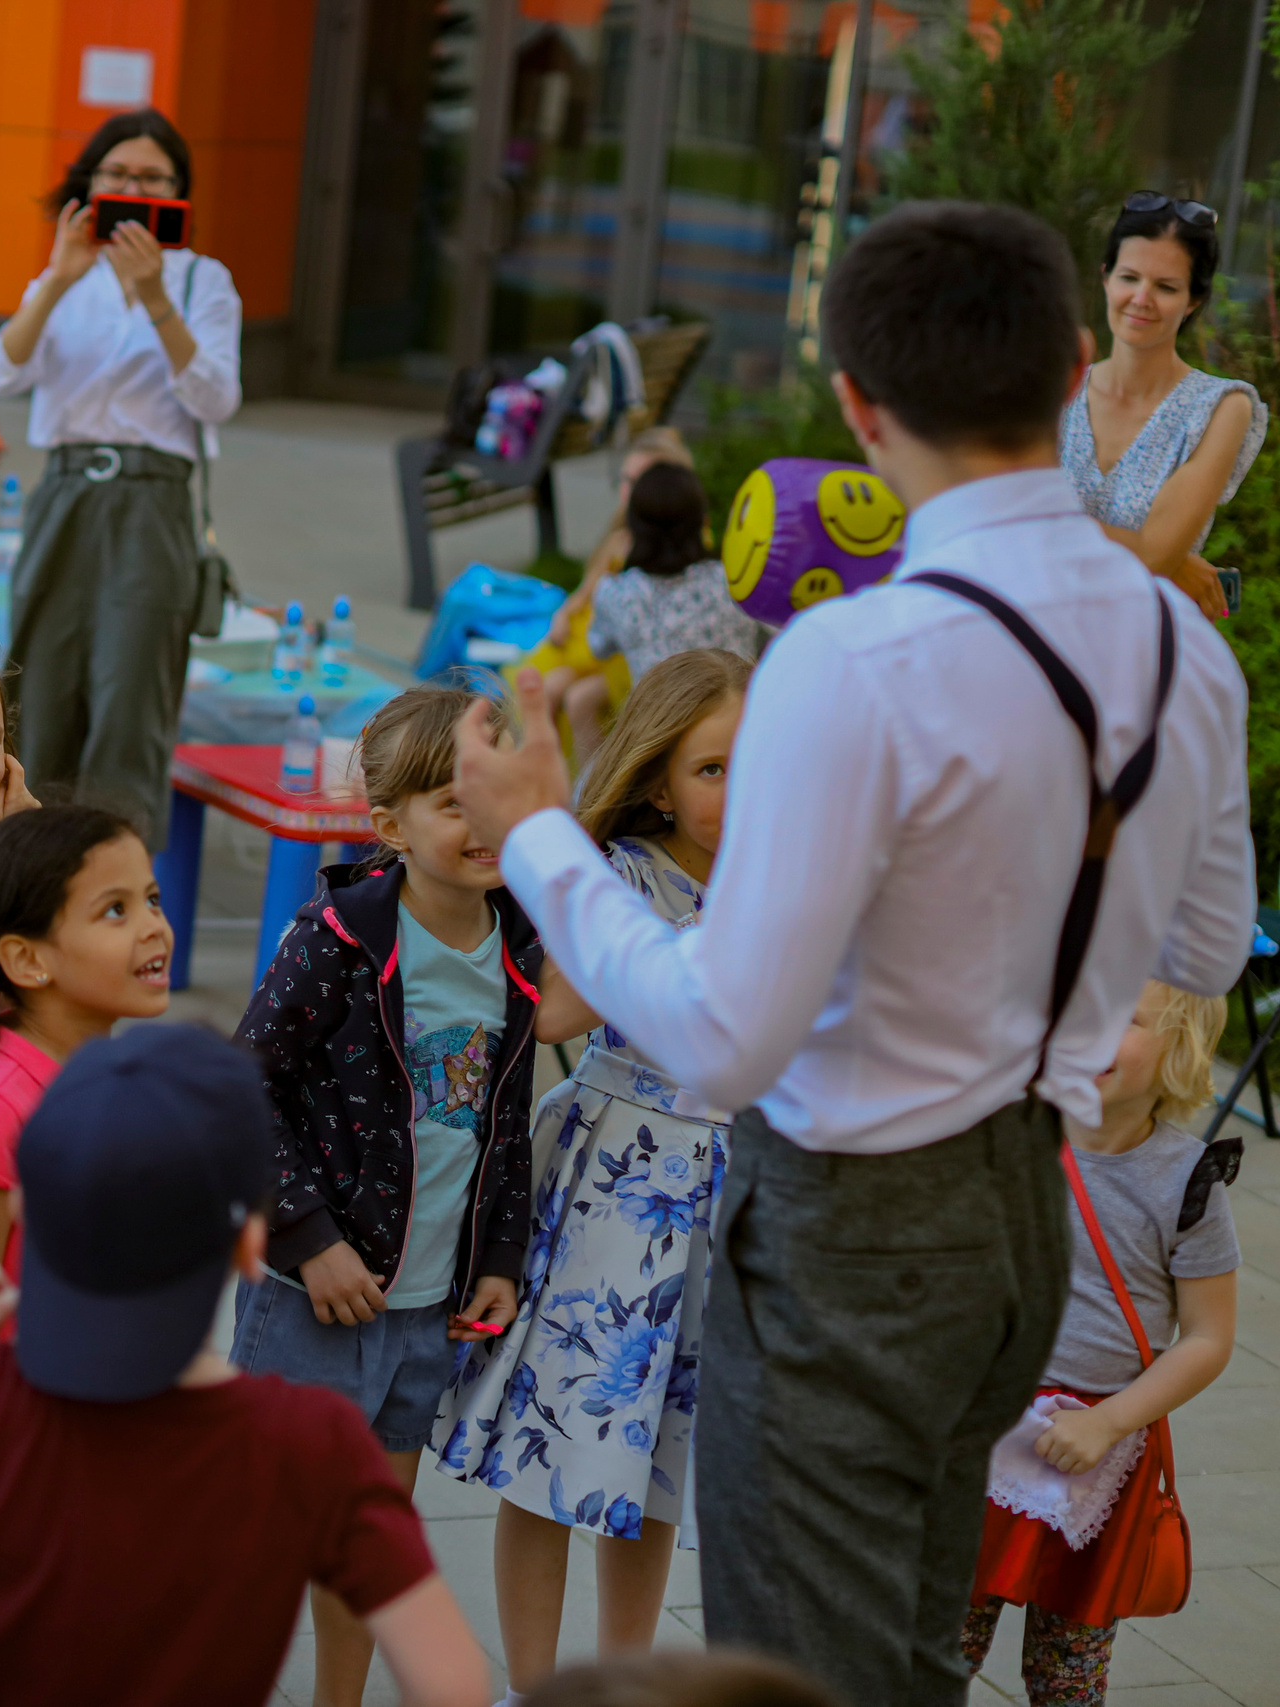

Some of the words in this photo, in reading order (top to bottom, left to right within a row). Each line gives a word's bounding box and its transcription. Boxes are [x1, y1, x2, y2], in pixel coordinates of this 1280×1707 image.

[319, 981, 331, 997] fun
[325, 1114, 338, 1129] fun
[278, 1198, 294, 1211] fun
